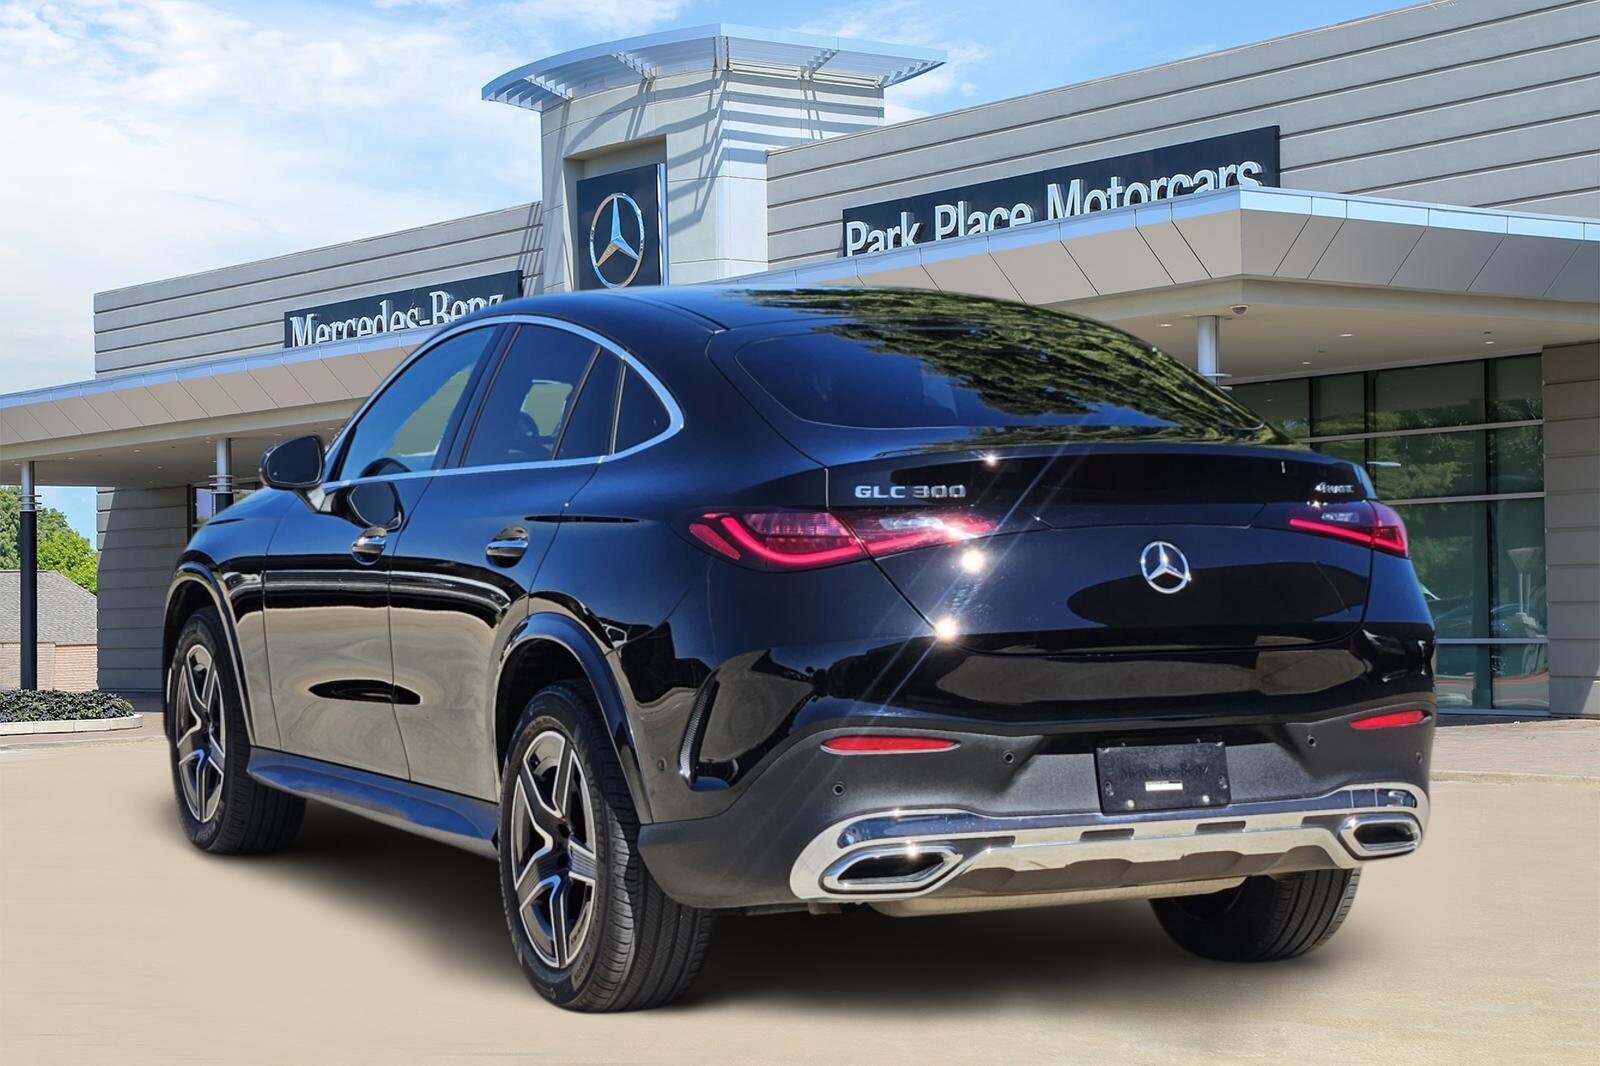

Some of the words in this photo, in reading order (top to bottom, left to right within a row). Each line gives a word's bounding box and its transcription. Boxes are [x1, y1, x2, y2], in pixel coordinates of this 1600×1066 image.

[846, 211, 922, 257] Park
[935, 200, 1034, 241] Place
[1047, 160, 1263, 220] Motorcars
[855, 485, 906, 498] GLC
[912, 484, 966, 498] 300
